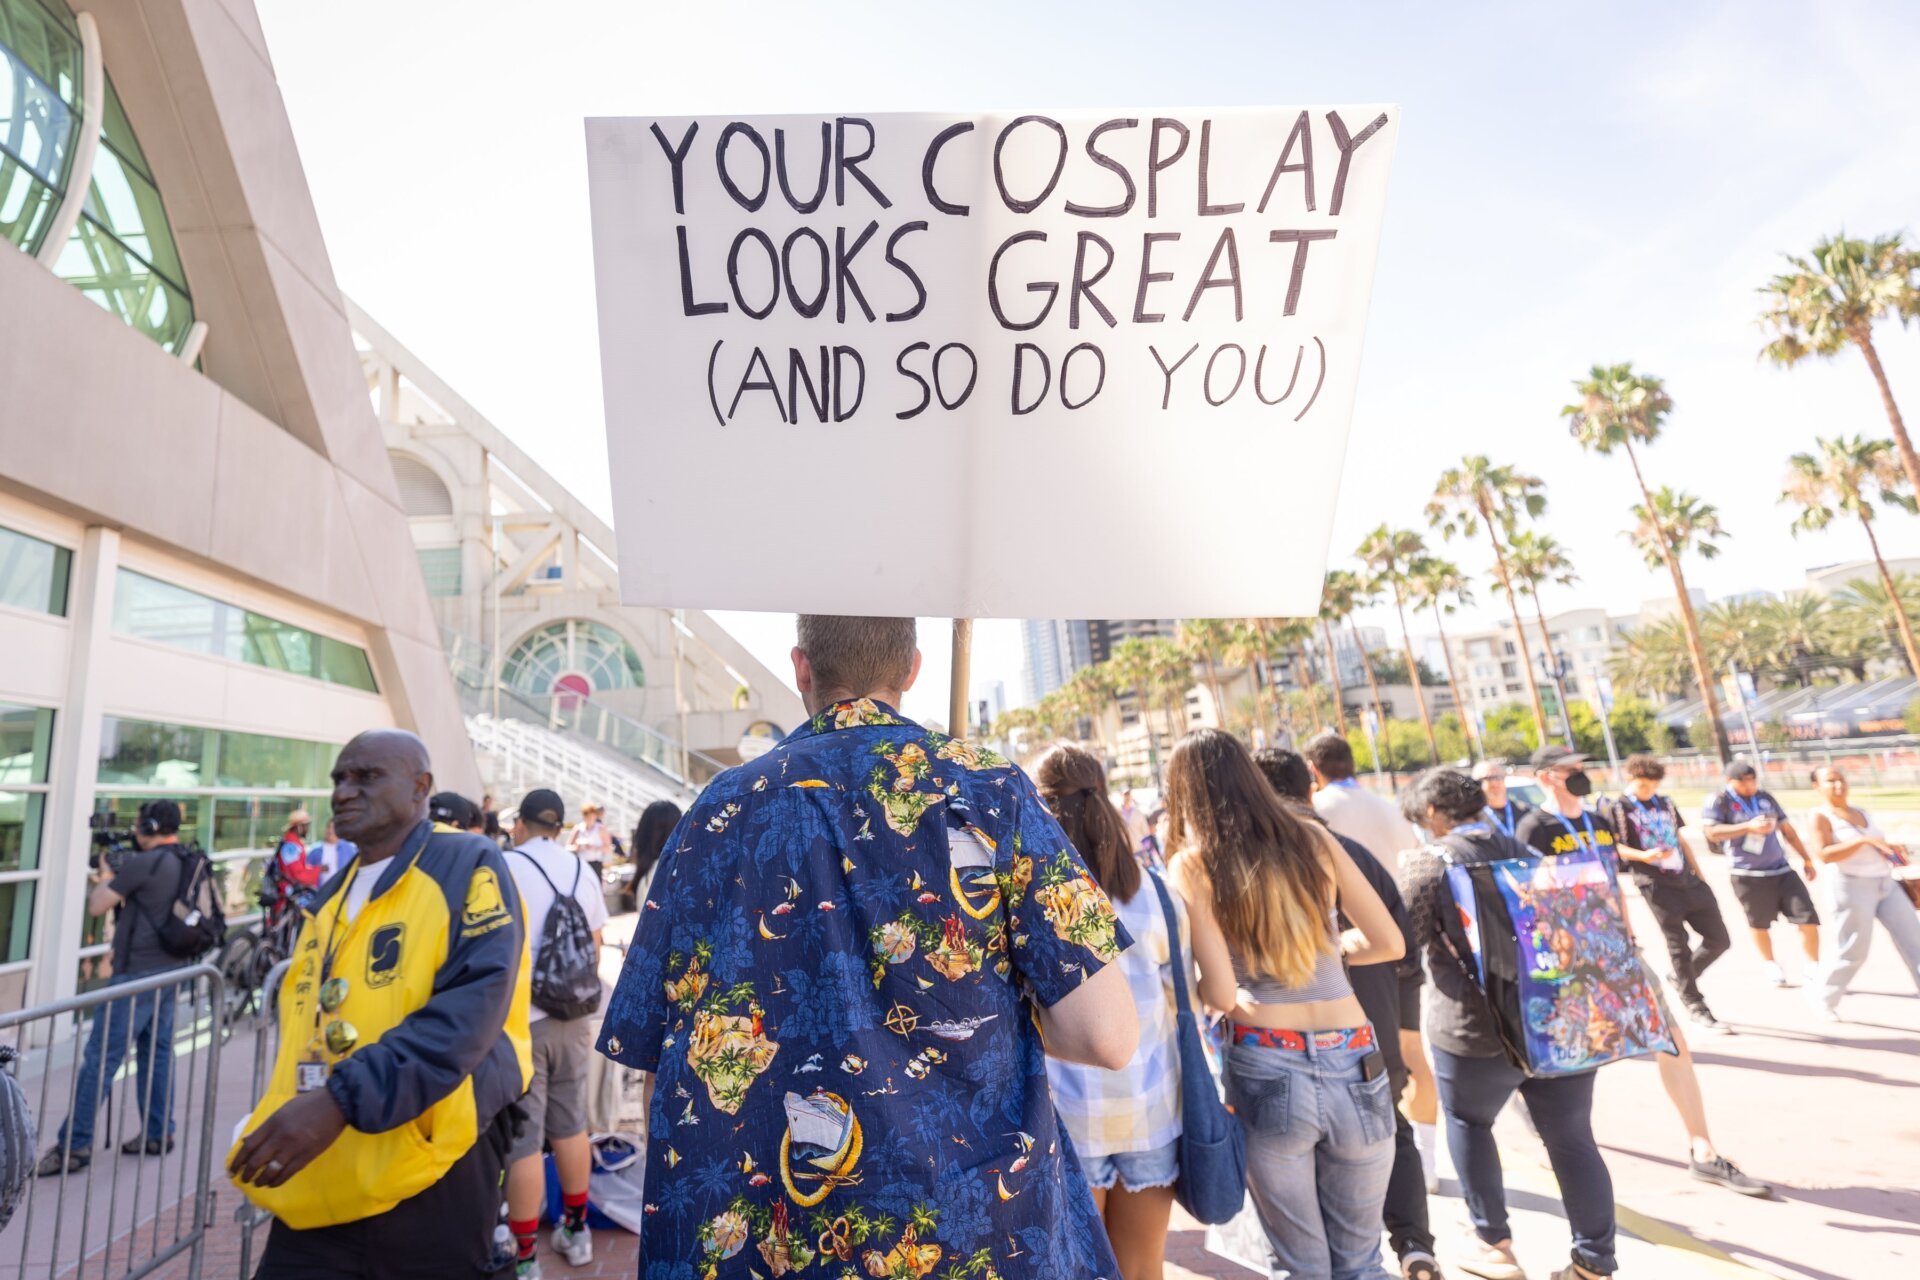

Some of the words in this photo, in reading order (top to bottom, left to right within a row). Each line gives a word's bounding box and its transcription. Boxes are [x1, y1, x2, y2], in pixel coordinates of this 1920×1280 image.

[649, 116, 894, 215] YOUR
[921, 110, 1388, 218] COSPLAY
[676, 220, 929, 325] LOOKS
[988, 227, 1338, 331] GREAT
[707, 340, 866, 427] (AND
[896, 341, 978, 420] SO
[1010, 341, 1106, 416] DO
[1149, 336, 1326, 423] YOU)
